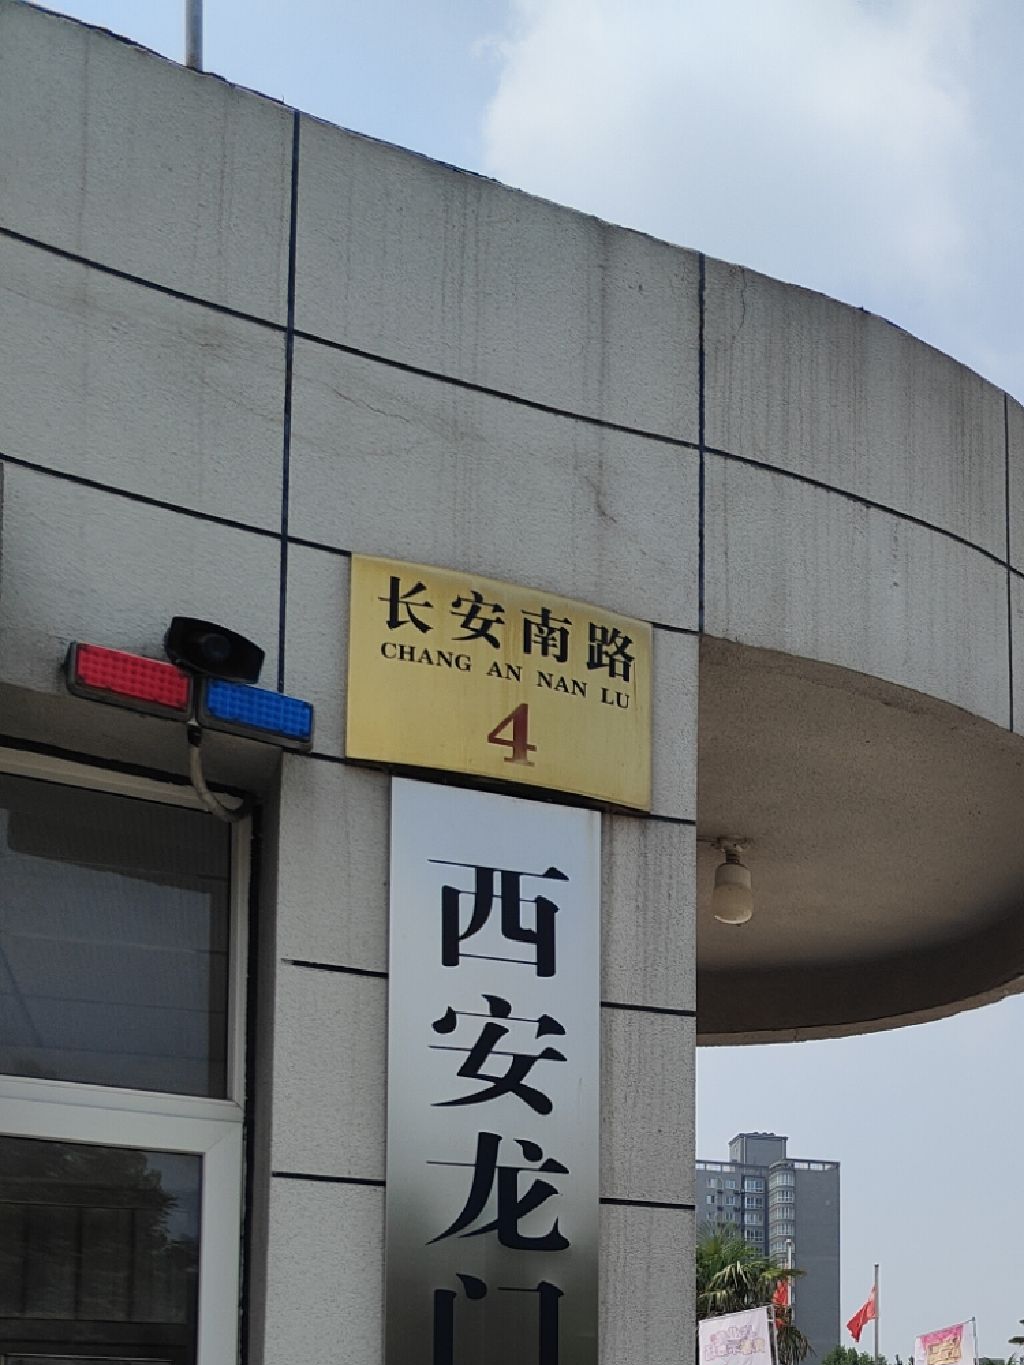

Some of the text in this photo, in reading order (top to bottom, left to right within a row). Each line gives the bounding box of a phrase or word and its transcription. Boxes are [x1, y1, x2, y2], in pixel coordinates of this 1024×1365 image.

[378, 575, 635, 682] 长安南路
[380, 641, 631, 709] CHANG AN NAN LU
[486, 702, 538, 768] 4
